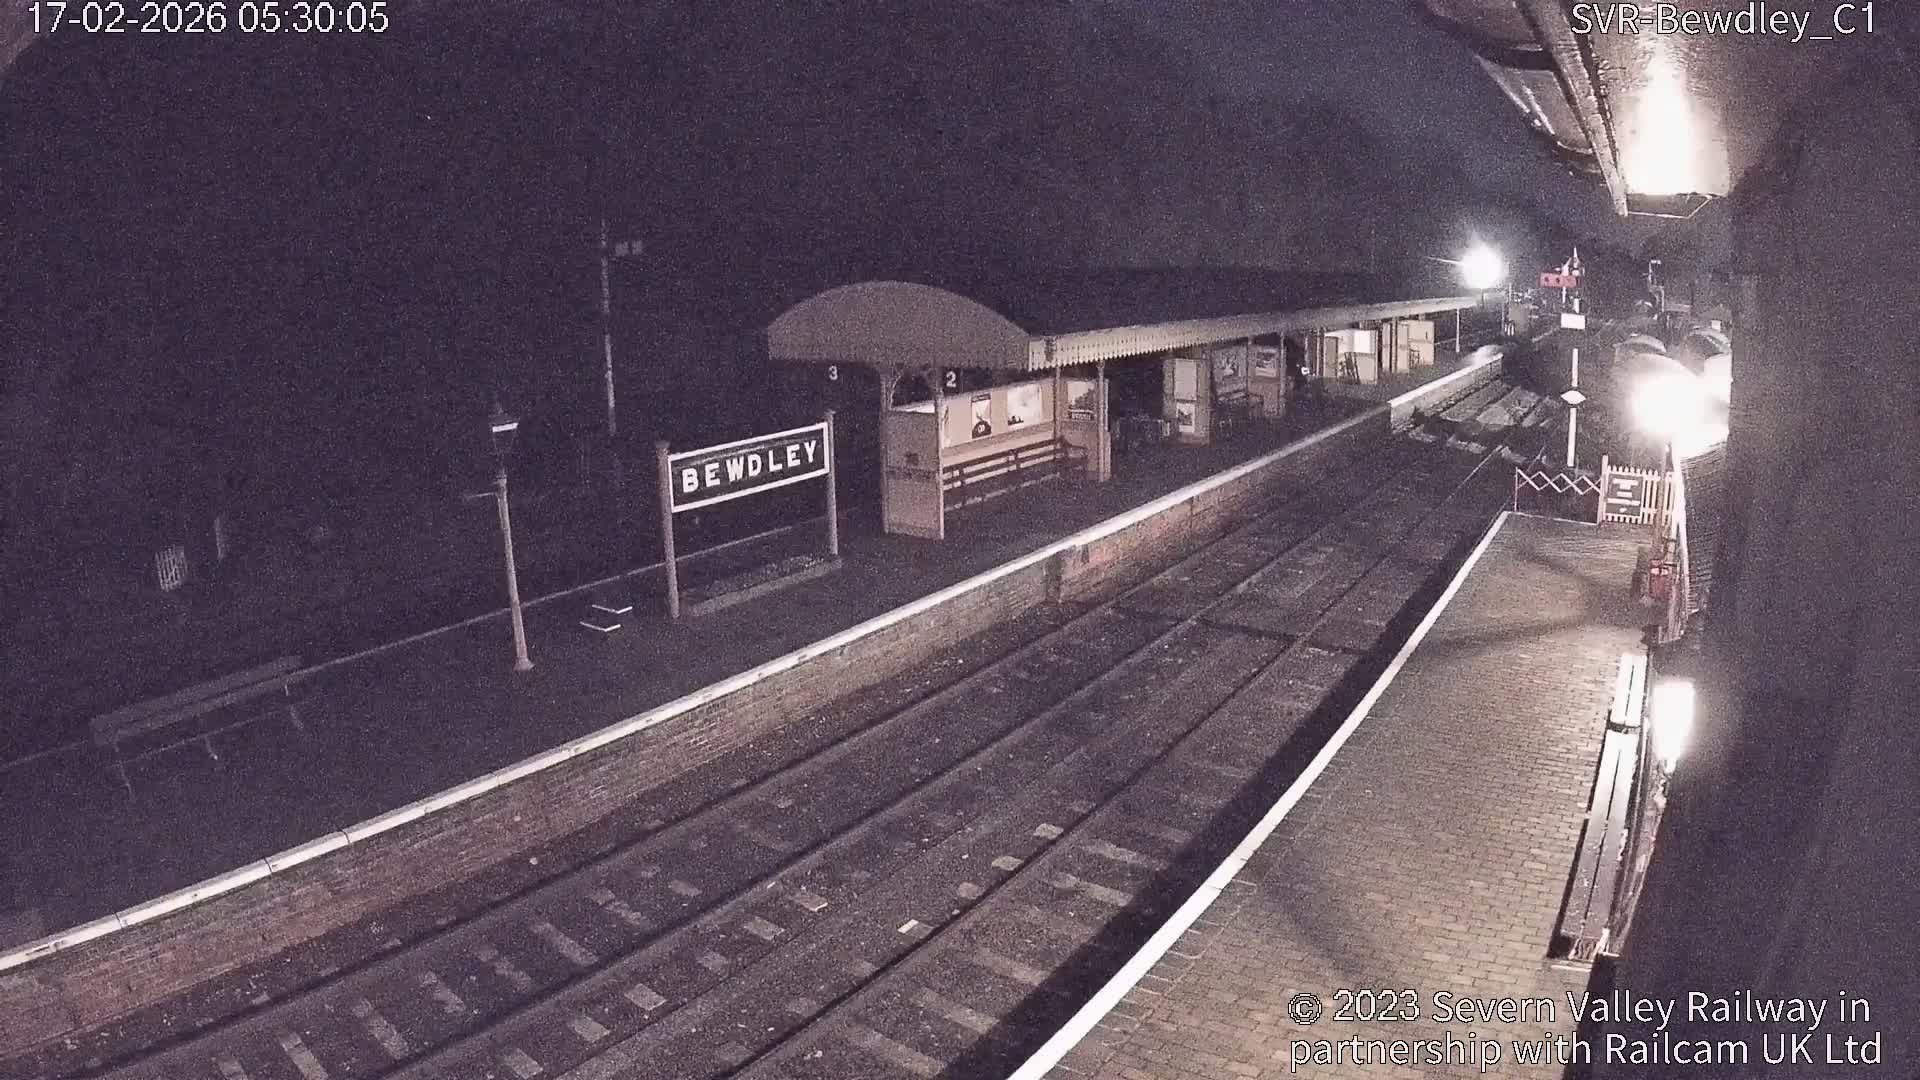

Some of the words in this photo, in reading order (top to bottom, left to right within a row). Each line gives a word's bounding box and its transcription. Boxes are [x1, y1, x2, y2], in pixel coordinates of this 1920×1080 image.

[829, 365, 838, 381] 3
[946, 370, 957, 388] 2
[681, 440, 817, 493] BEWDLEY
